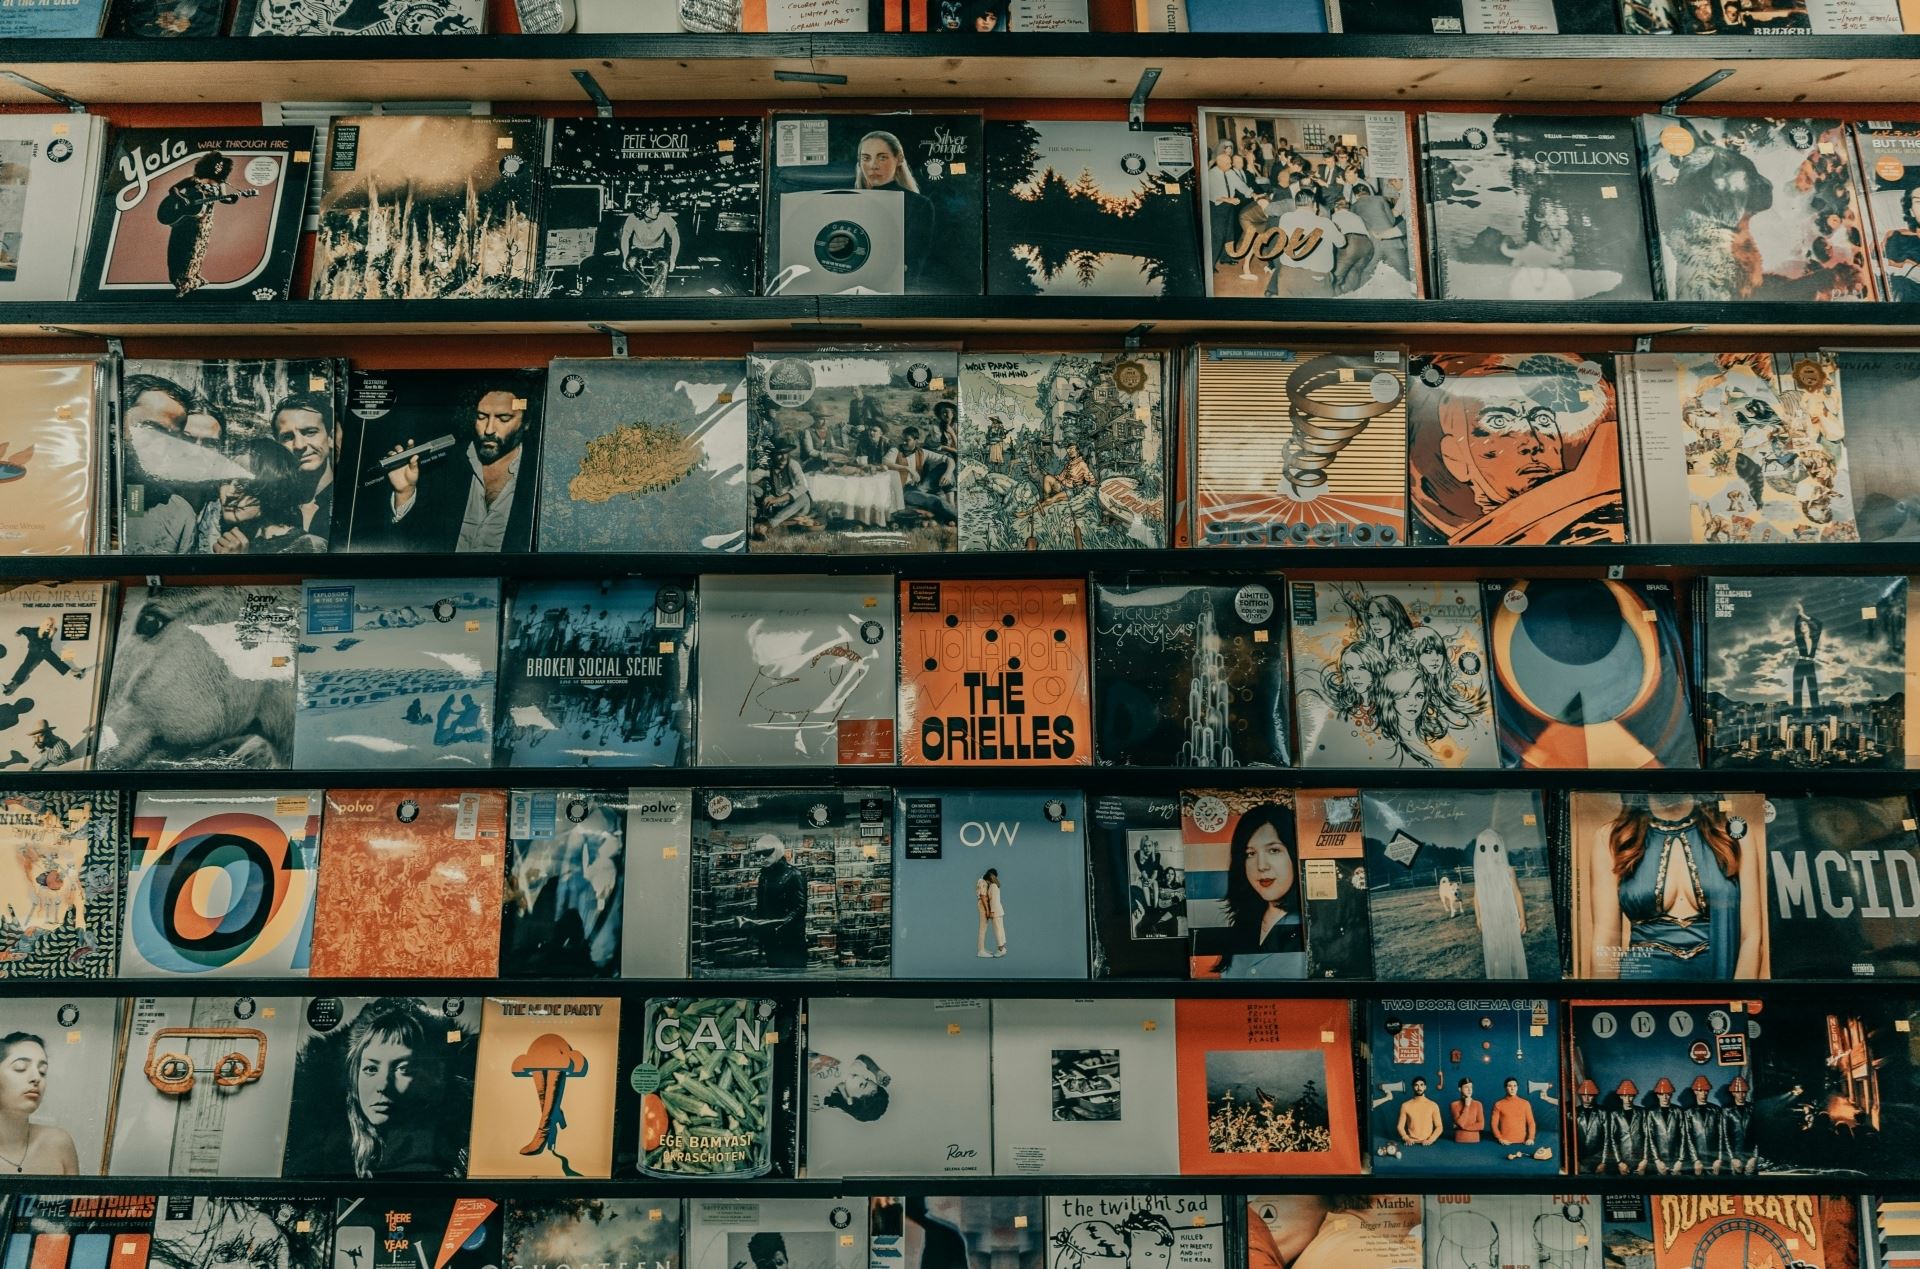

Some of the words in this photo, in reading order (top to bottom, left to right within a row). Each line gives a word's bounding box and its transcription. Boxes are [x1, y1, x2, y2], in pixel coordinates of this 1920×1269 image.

[622, 134, 646, 149] PETE
[650, 134, 688, 149] YORN
[934, 127, 968, 145] Silver
[1871, 139, 1896, 148] BUT
[197, 140, 222, 149] WALK
[225, 139, 267, 149] THROUGH
[269, 139, 288, 149] FIRE
[919, 143, 968, 162] Tongue
[1534, 151, 1630, 166] COTILLIONS
[116, 138, 188, 205] Yola
[965, 363, 986, 371] WOLF
[988, 361, 1020, 371] PARADE
[1008, 370, 1028, 379] MIND
[526, 657, 575, 678] BROKEN
[578, 657, 622, 677] SOCIAL
[626, 657, 663, 677] SCENE
[963, 672, 1024, 715] THE
[921, 715, 1075, 761] ORIELLES
[338, 800, 374, 815] polvo
[959, 821, 1020, 847] OW
[1316, 834, 1346, 847] CENTER
[502, 1003, 526, 1016] THE
[563, 1003, 603, 1017] PARTY
[1382, 999, 1413, 1011] TWO
[1416, 999, 1455, 1011] DOOR
[1459, 999, 1510, 1011] CINEMA
[654, 1017, 761, 1053] CAN
[659, 1134, 683, 1148] EGE
[689, 1133, 752, 1148] BAMYASI
[663, 1149, 746, 1163] OKRASCHOTEN
[947, 1144, 977, 1161] Rare
[1062, 1198, 1095, 1217] the
[1098, 1195, 1170, 1216] twilight
[1175, 1196, 1208, 1214] sad
[1376, 1197, 1415, 1210] Marble
[40, 1206, 66, 1218] THE
[384, 1210, 412, 1223] THERE
[388, 1223, 397, 1231] IS
[1661, 1194, 1736, 1252] DUNE
[1745, 1194, 1817, 1250] RATS
[384, 1240, 409, 1251] YEAR
